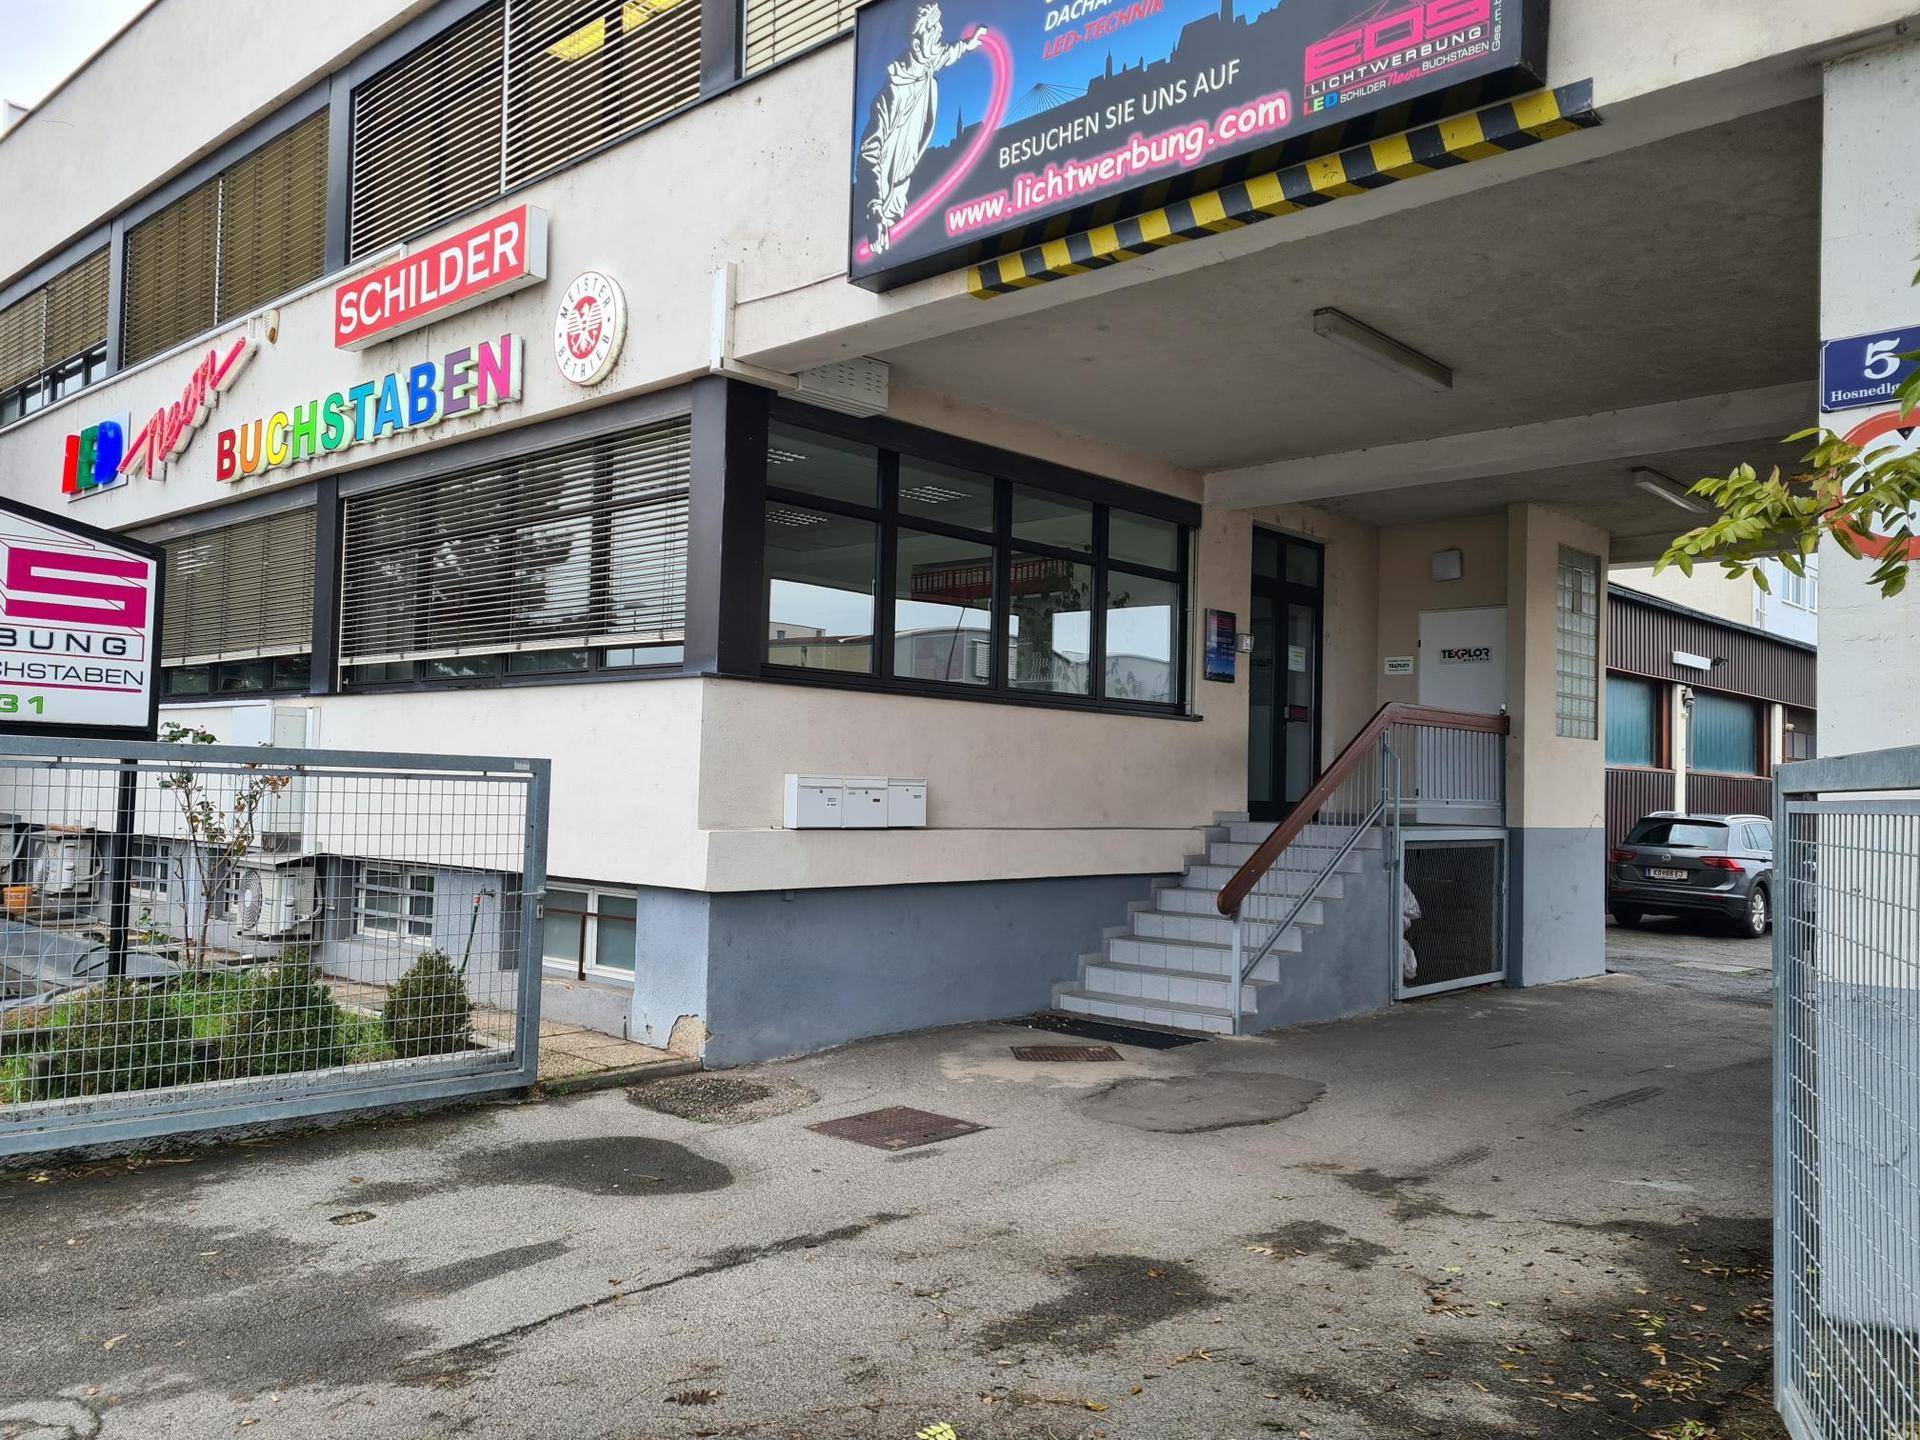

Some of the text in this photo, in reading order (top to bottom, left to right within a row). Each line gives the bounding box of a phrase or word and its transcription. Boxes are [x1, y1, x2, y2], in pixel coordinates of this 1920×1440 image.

[1303, 91, 1338, 115] LED
[1340, 79, 1387, 104] SCHILDER
[1422, 41, 1489, 71] BUCHSTABEN
[1311, 26, 1482, 95] LICHTWERBUNG
[999, 59, 1240, 169] BESUCHEN SIE UNS AUF
[948, 96, 1287, 231] www.lichtwerbung.com
[339, 221, 519, 334] SCHILDER
[560, 277, 611, 319] MEISTER
[1864, 338, 1900, 379] 5
[216, 333, 511, 482] BUCHSTABEN
[0, 660, 144, 686] HSTABEN
[1441, 647, 1490, 659] TEXPLOR
